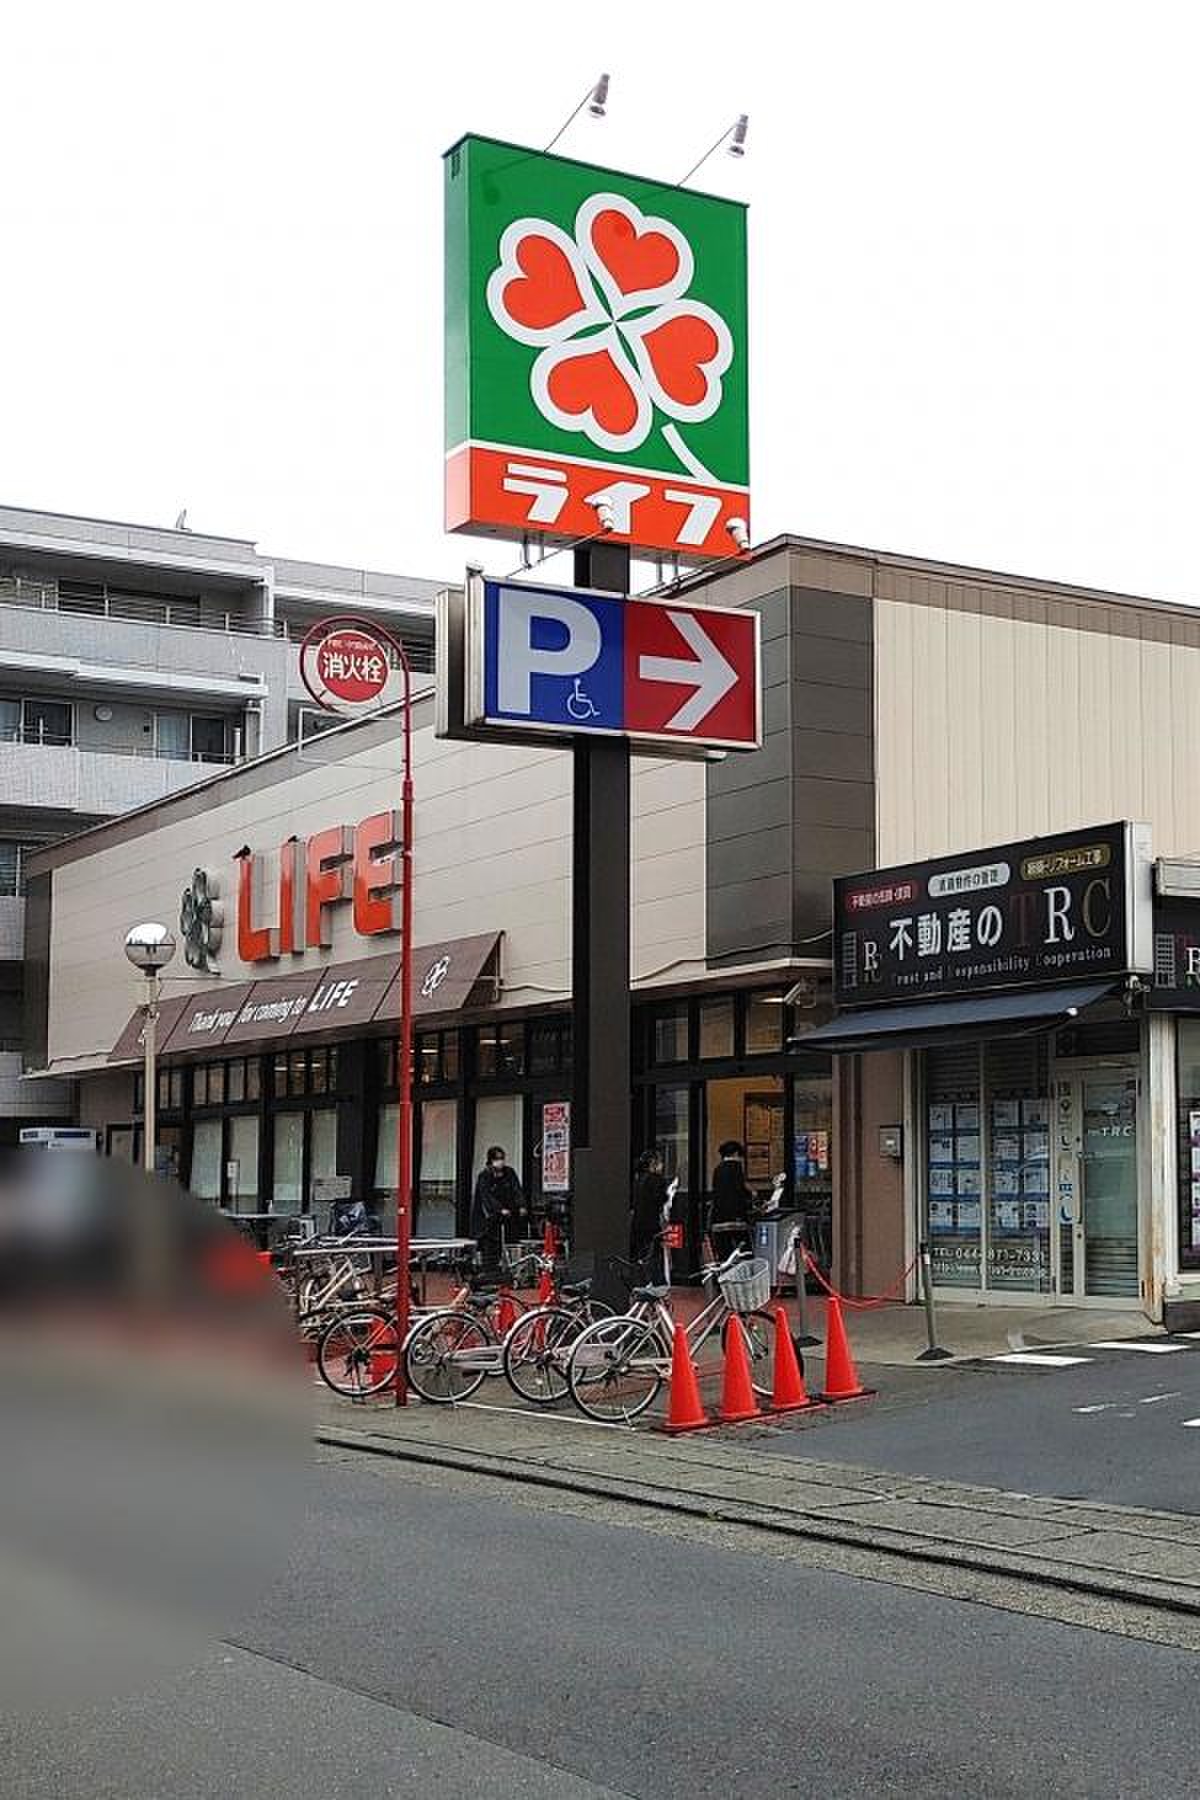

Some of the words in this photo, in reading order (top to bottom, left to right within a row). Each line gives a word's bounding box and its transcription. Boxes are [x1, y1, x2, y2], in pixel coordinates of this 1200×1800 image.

[503, 463, 724, 545] ライフ
[323, 651, 384, 683] 消火栓
[498, 588, 602, 715] P
[237, 810, 402, 962] LIFE
[307, 979, 360, 1012] LIFE
